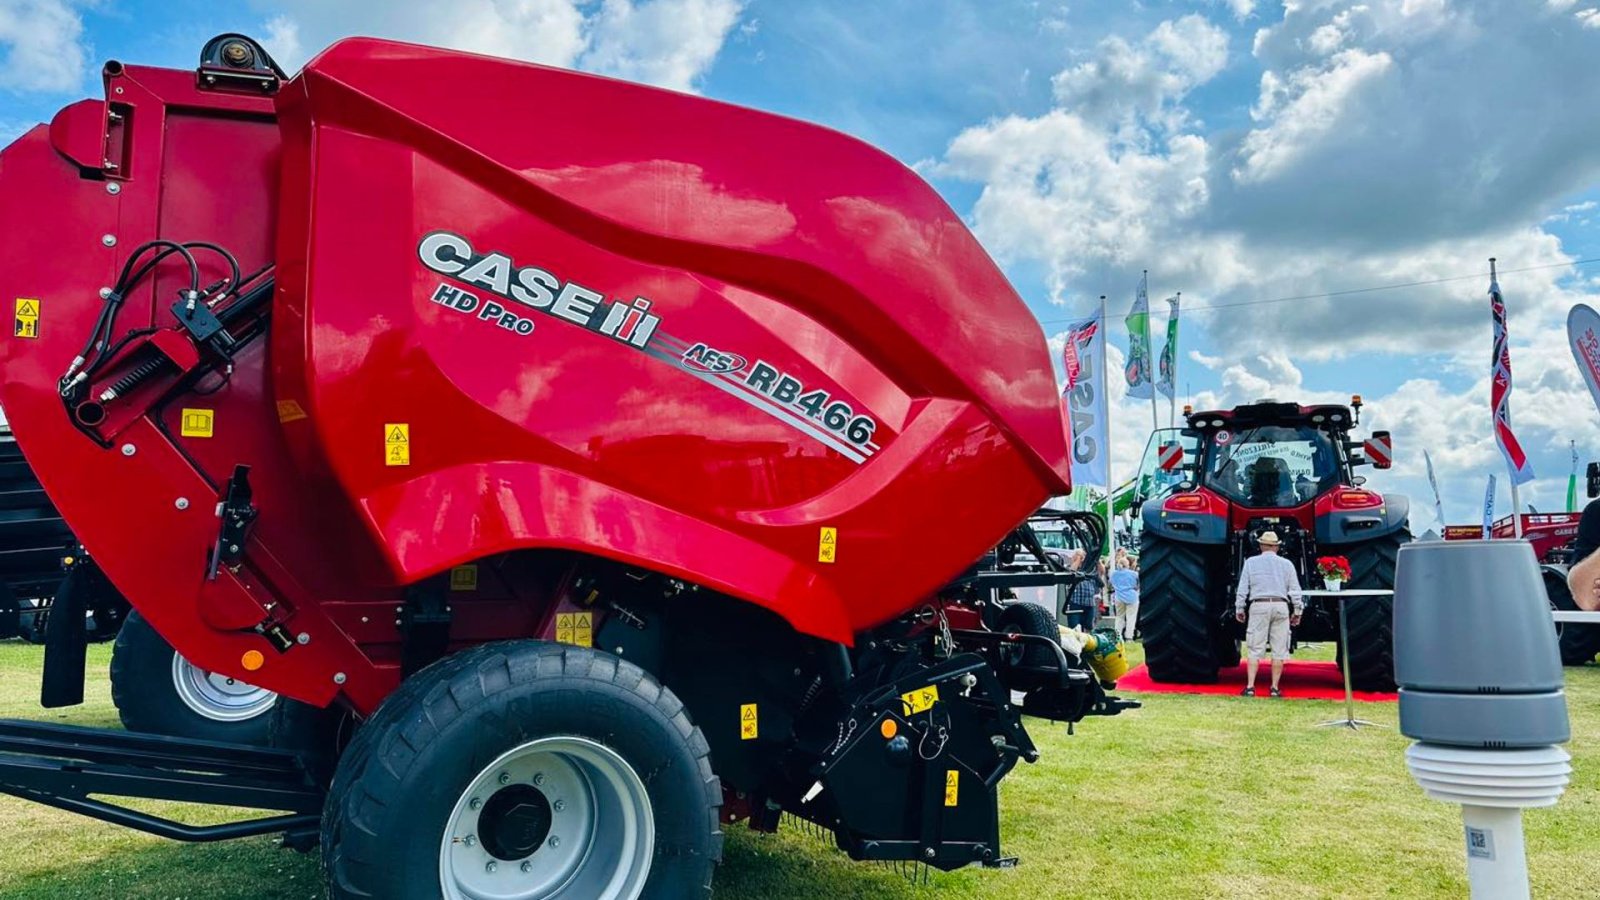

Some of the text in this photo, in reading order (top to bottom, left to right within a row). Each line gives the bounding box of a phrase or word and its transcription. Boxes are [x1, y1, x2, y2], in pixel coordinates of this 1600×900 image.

[418, 232, 604, 326] CASE
[431, 283, 479, 314] HD
[683, 344, 735, 373] AFS
[743, 359, 877, 448] RB466
